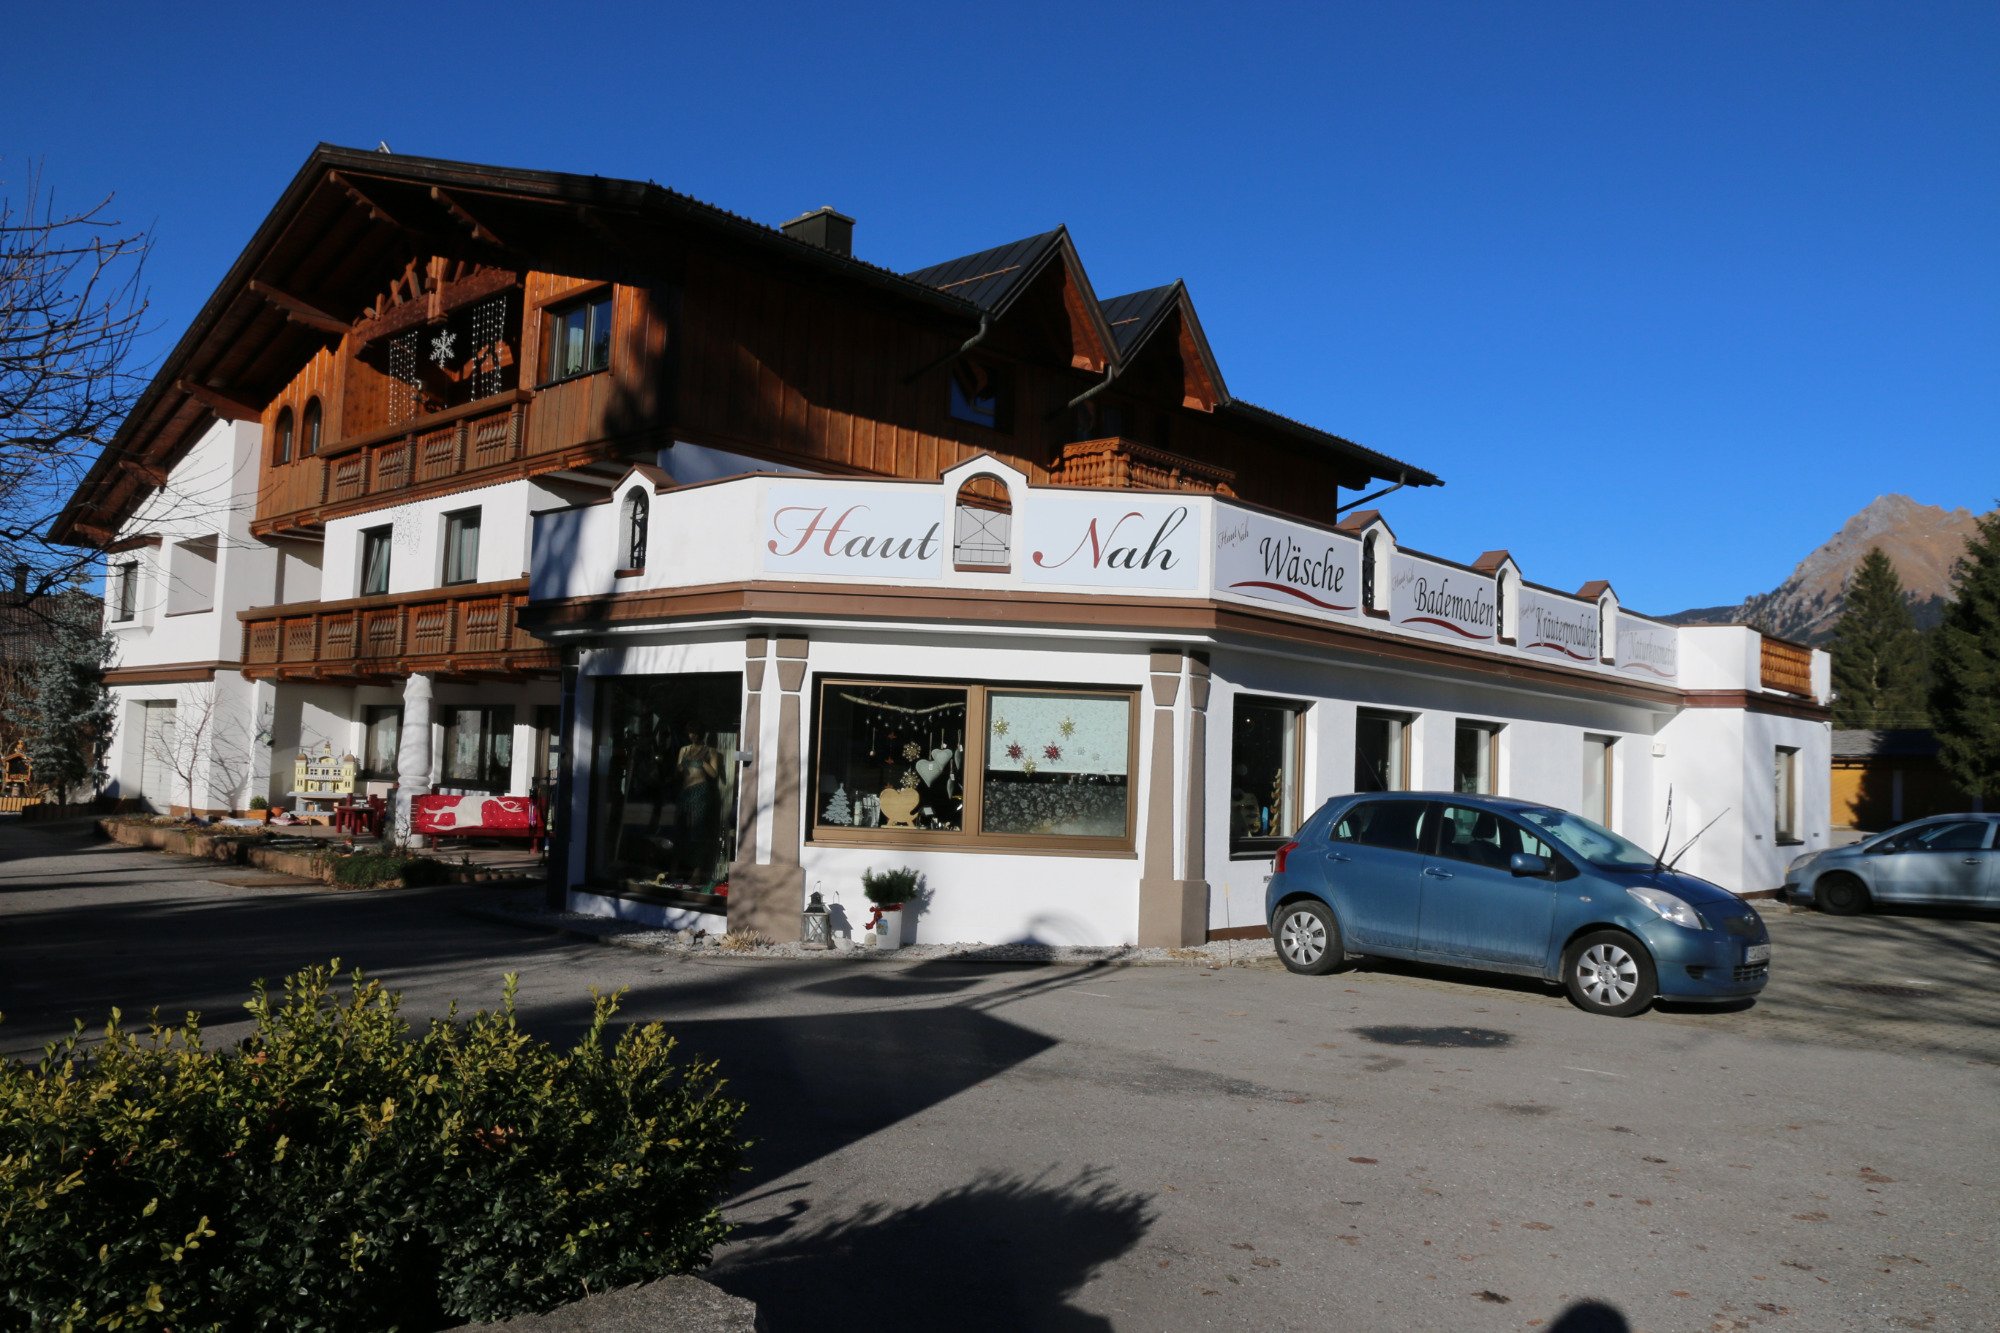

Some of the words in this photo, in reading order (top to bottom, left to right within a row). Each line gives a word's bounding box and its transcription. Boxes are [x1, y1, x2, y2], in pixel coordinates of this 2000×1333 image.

[768, 504, 941, 561] Haut
[1032, 506, 1188, 571] Nah
[1218, 525, 1237, 549] Haut
[1259, 536, 1344, 592] Wäsche
[1414, 577, 1494, 627] Bademoden
[1535, 607, 1597, 657] Kräuterprodukte
